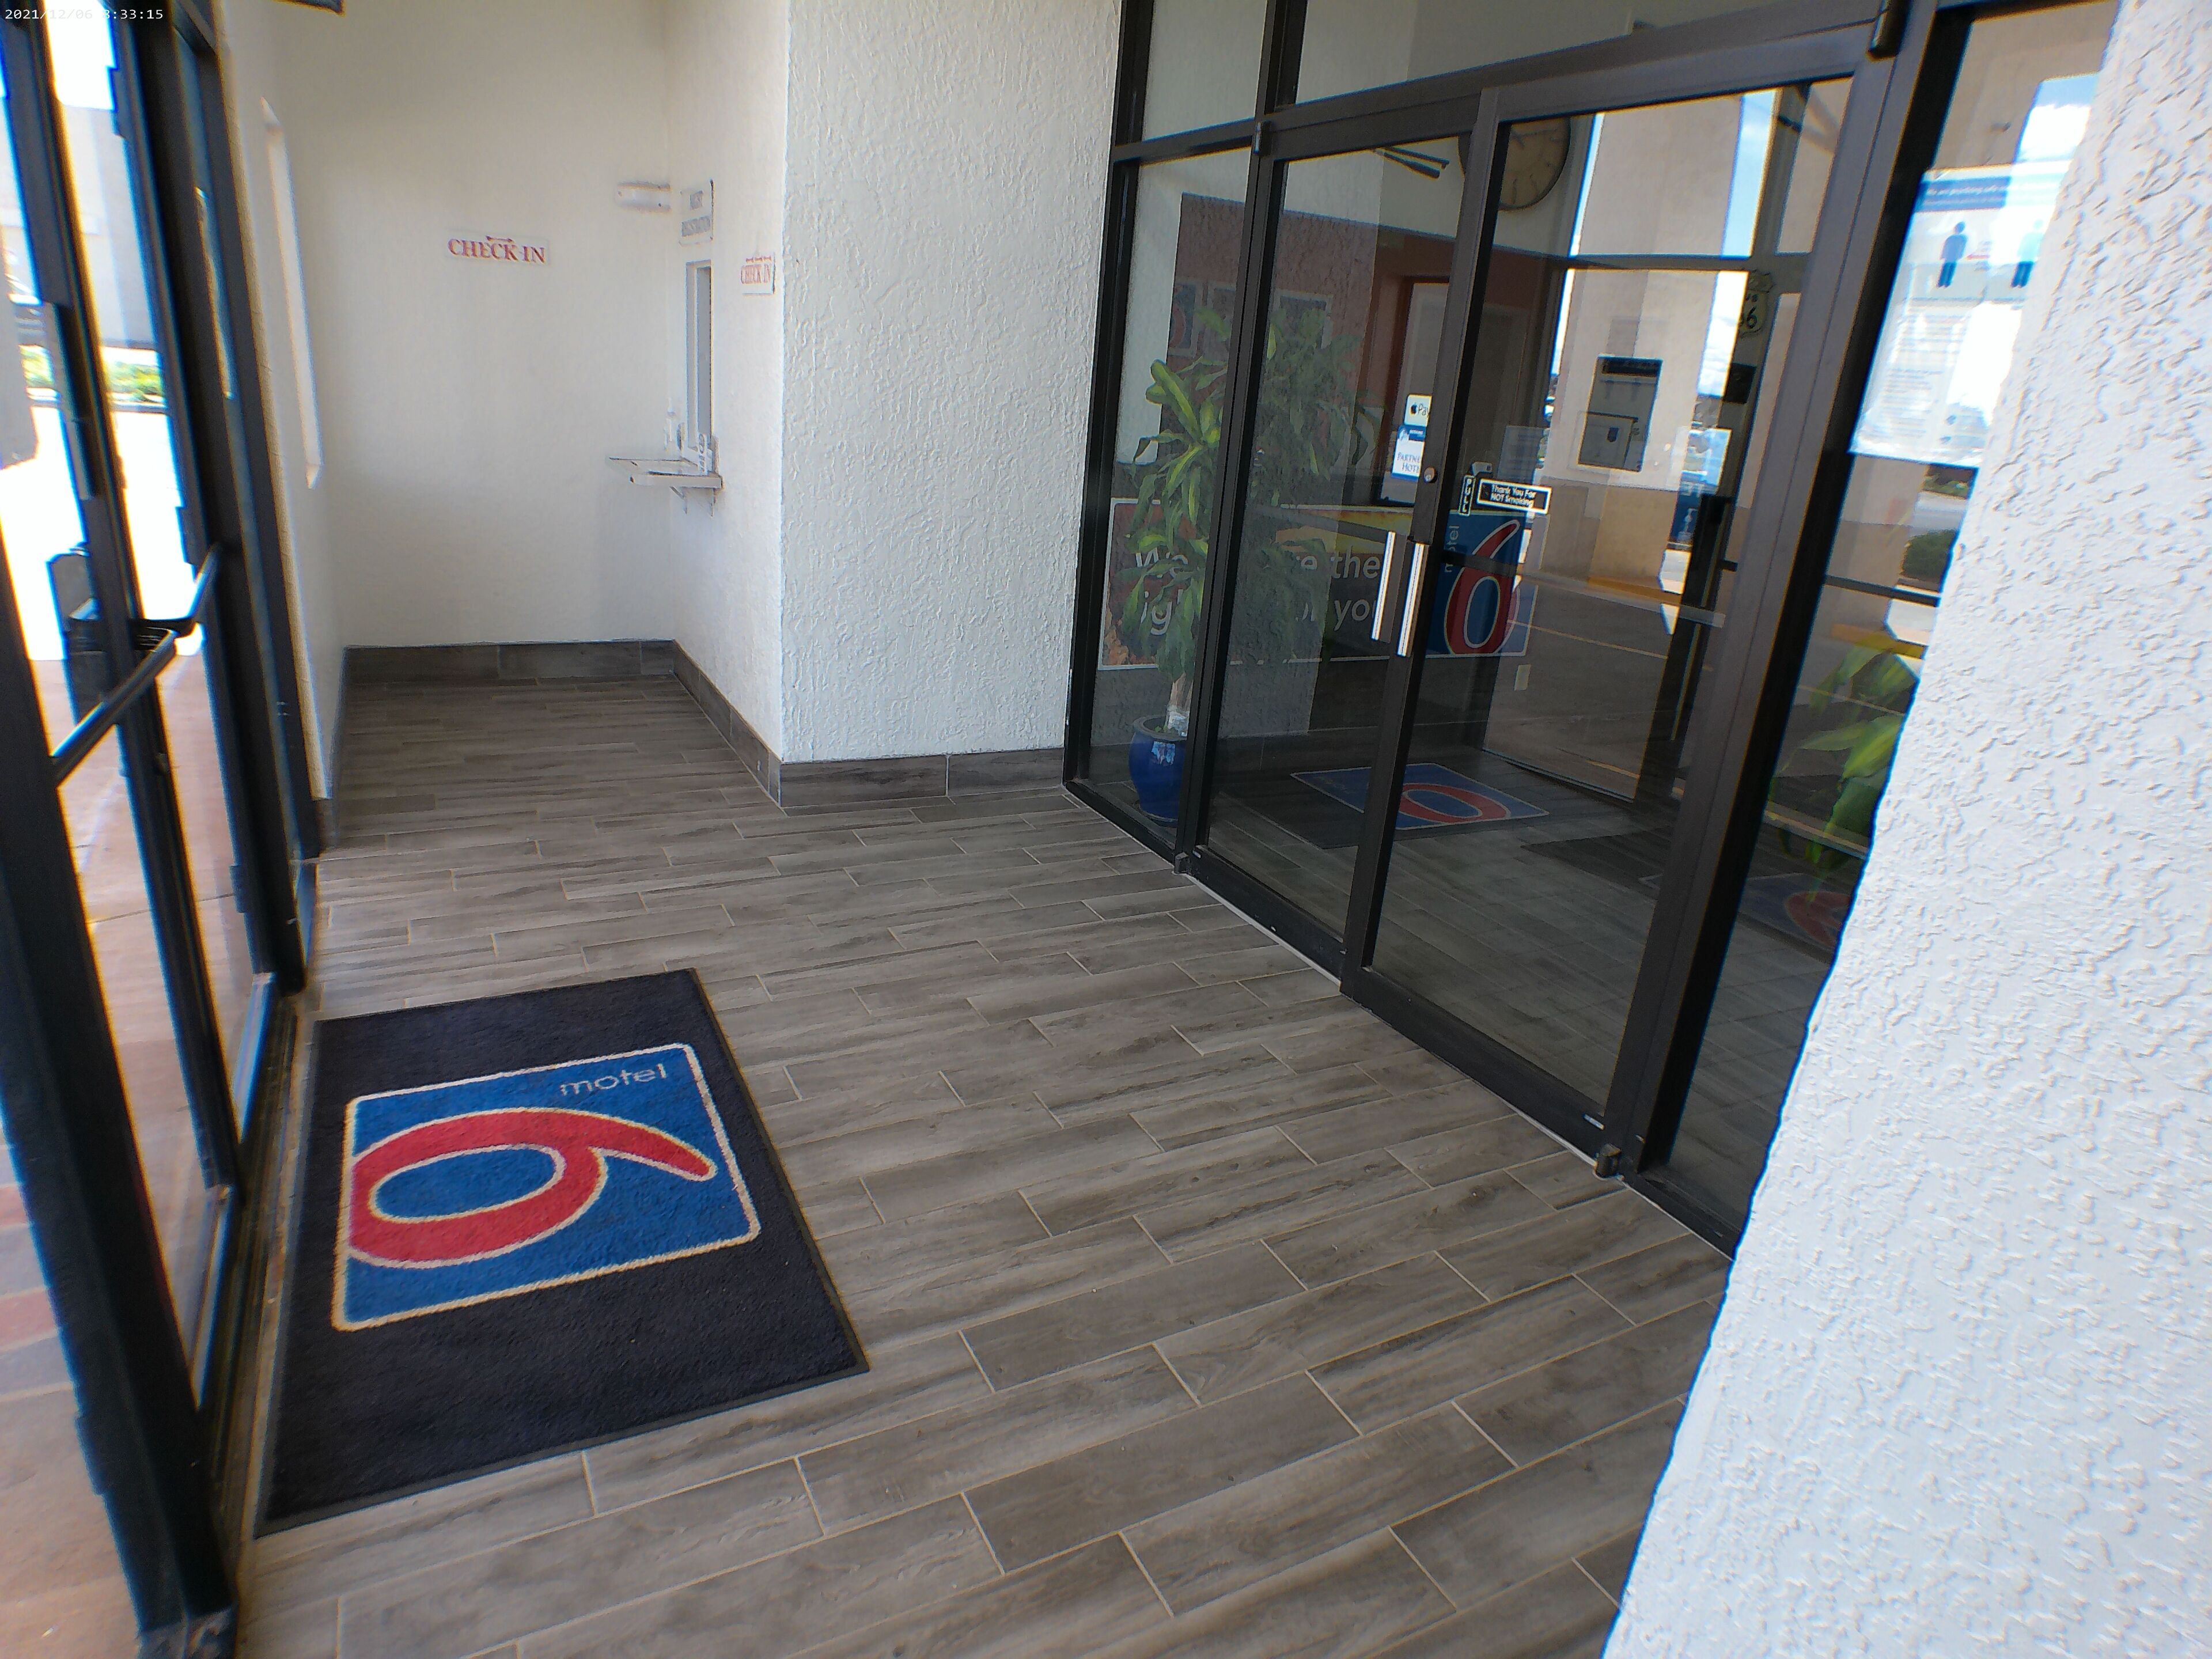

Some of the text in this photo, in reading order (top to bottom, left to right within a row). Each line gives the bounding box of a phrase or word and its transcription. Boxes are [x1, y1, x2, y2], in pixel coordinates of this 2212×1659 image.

[448, 238, 546, 263] CHECK IN
[1461, 478, 1472, 513] PULL
[1490, 493, 1505, 502] NOT
[1491, 484, 1512, 495] Thank
[1512, 487, 1524, 497] You
[1330, 545, 1381, 579] the
[559, 1063, 666, 1096] motel
[348, 1107, 718, 1270] 6
